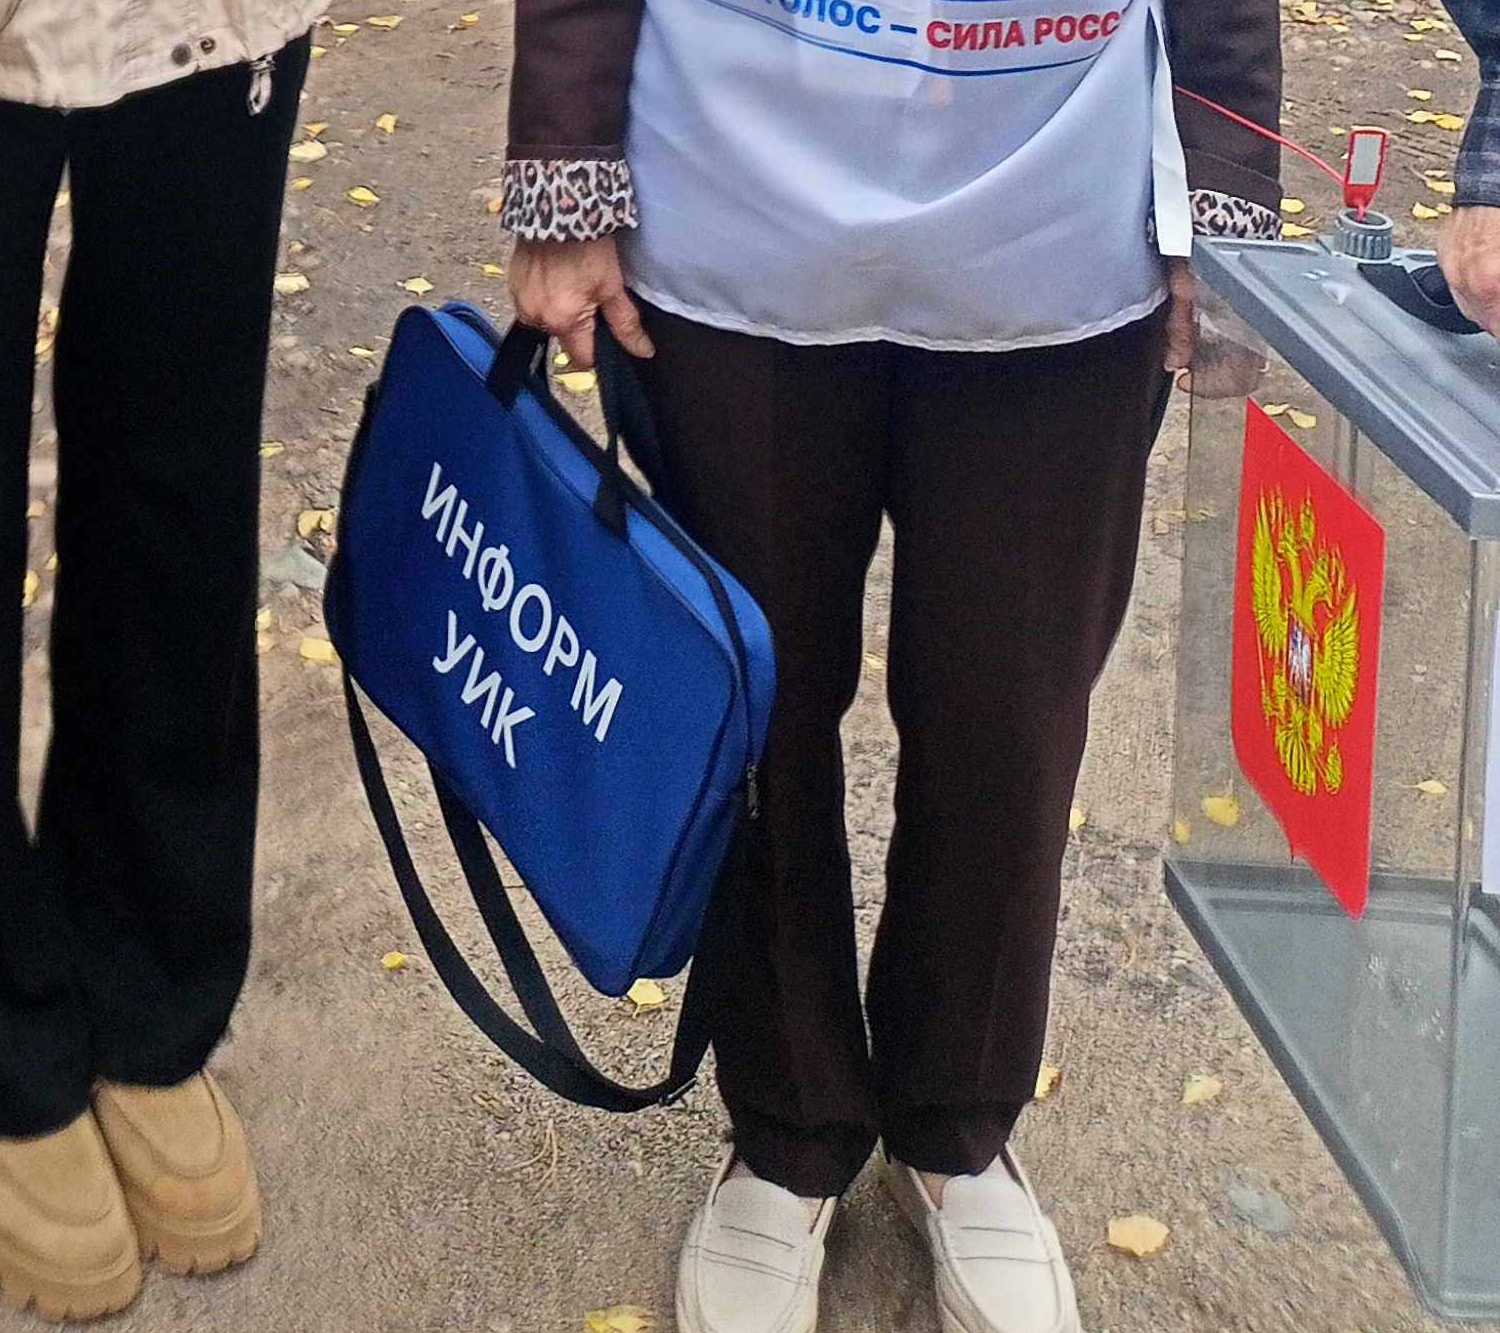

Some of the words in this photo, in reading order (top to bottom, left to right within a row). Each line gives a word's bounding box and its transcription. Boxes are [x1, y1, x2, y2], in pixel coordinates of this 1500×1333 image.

[926, 20, 1026, 52] СИЛА
[1033, 8, 1126, 46] РОСС
[421, 461, 623, 743] ИНФОРМ
[432, 609, 536, 770] УИК
